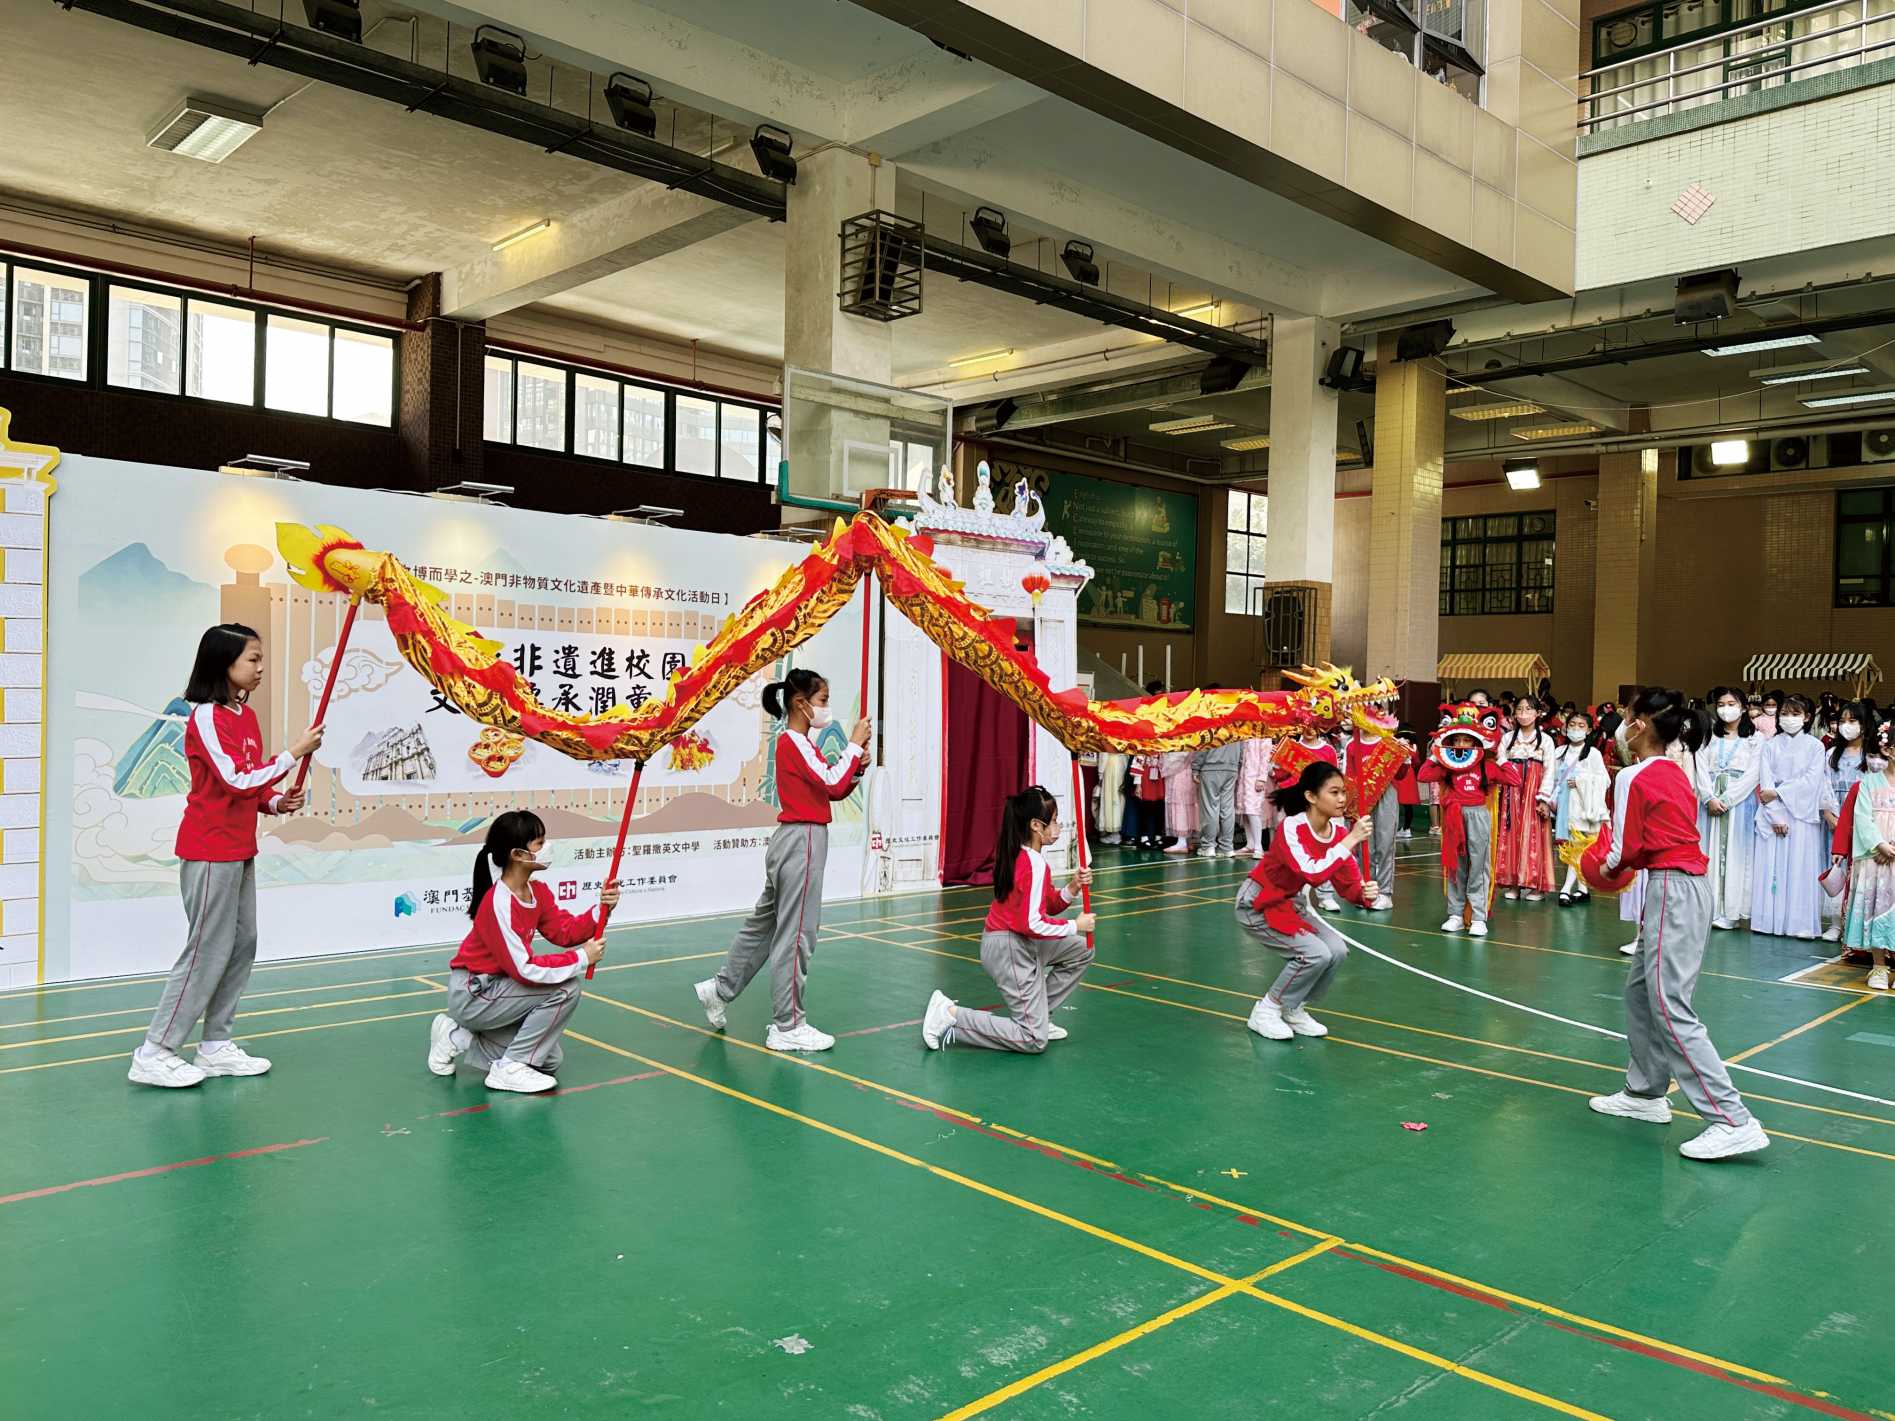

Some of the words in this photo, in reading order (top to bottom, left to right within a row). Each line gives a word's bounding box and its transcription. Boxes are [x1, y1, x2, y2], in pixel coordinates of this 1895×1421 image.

[403, 564, 729, 606] 博而學之-澳門非物質文化遺產暨中華傳承文化活動日】
[496, 642, 686, 680] 非遺進校園
[581, 874, 678, 891] 歷史化工作委員會
